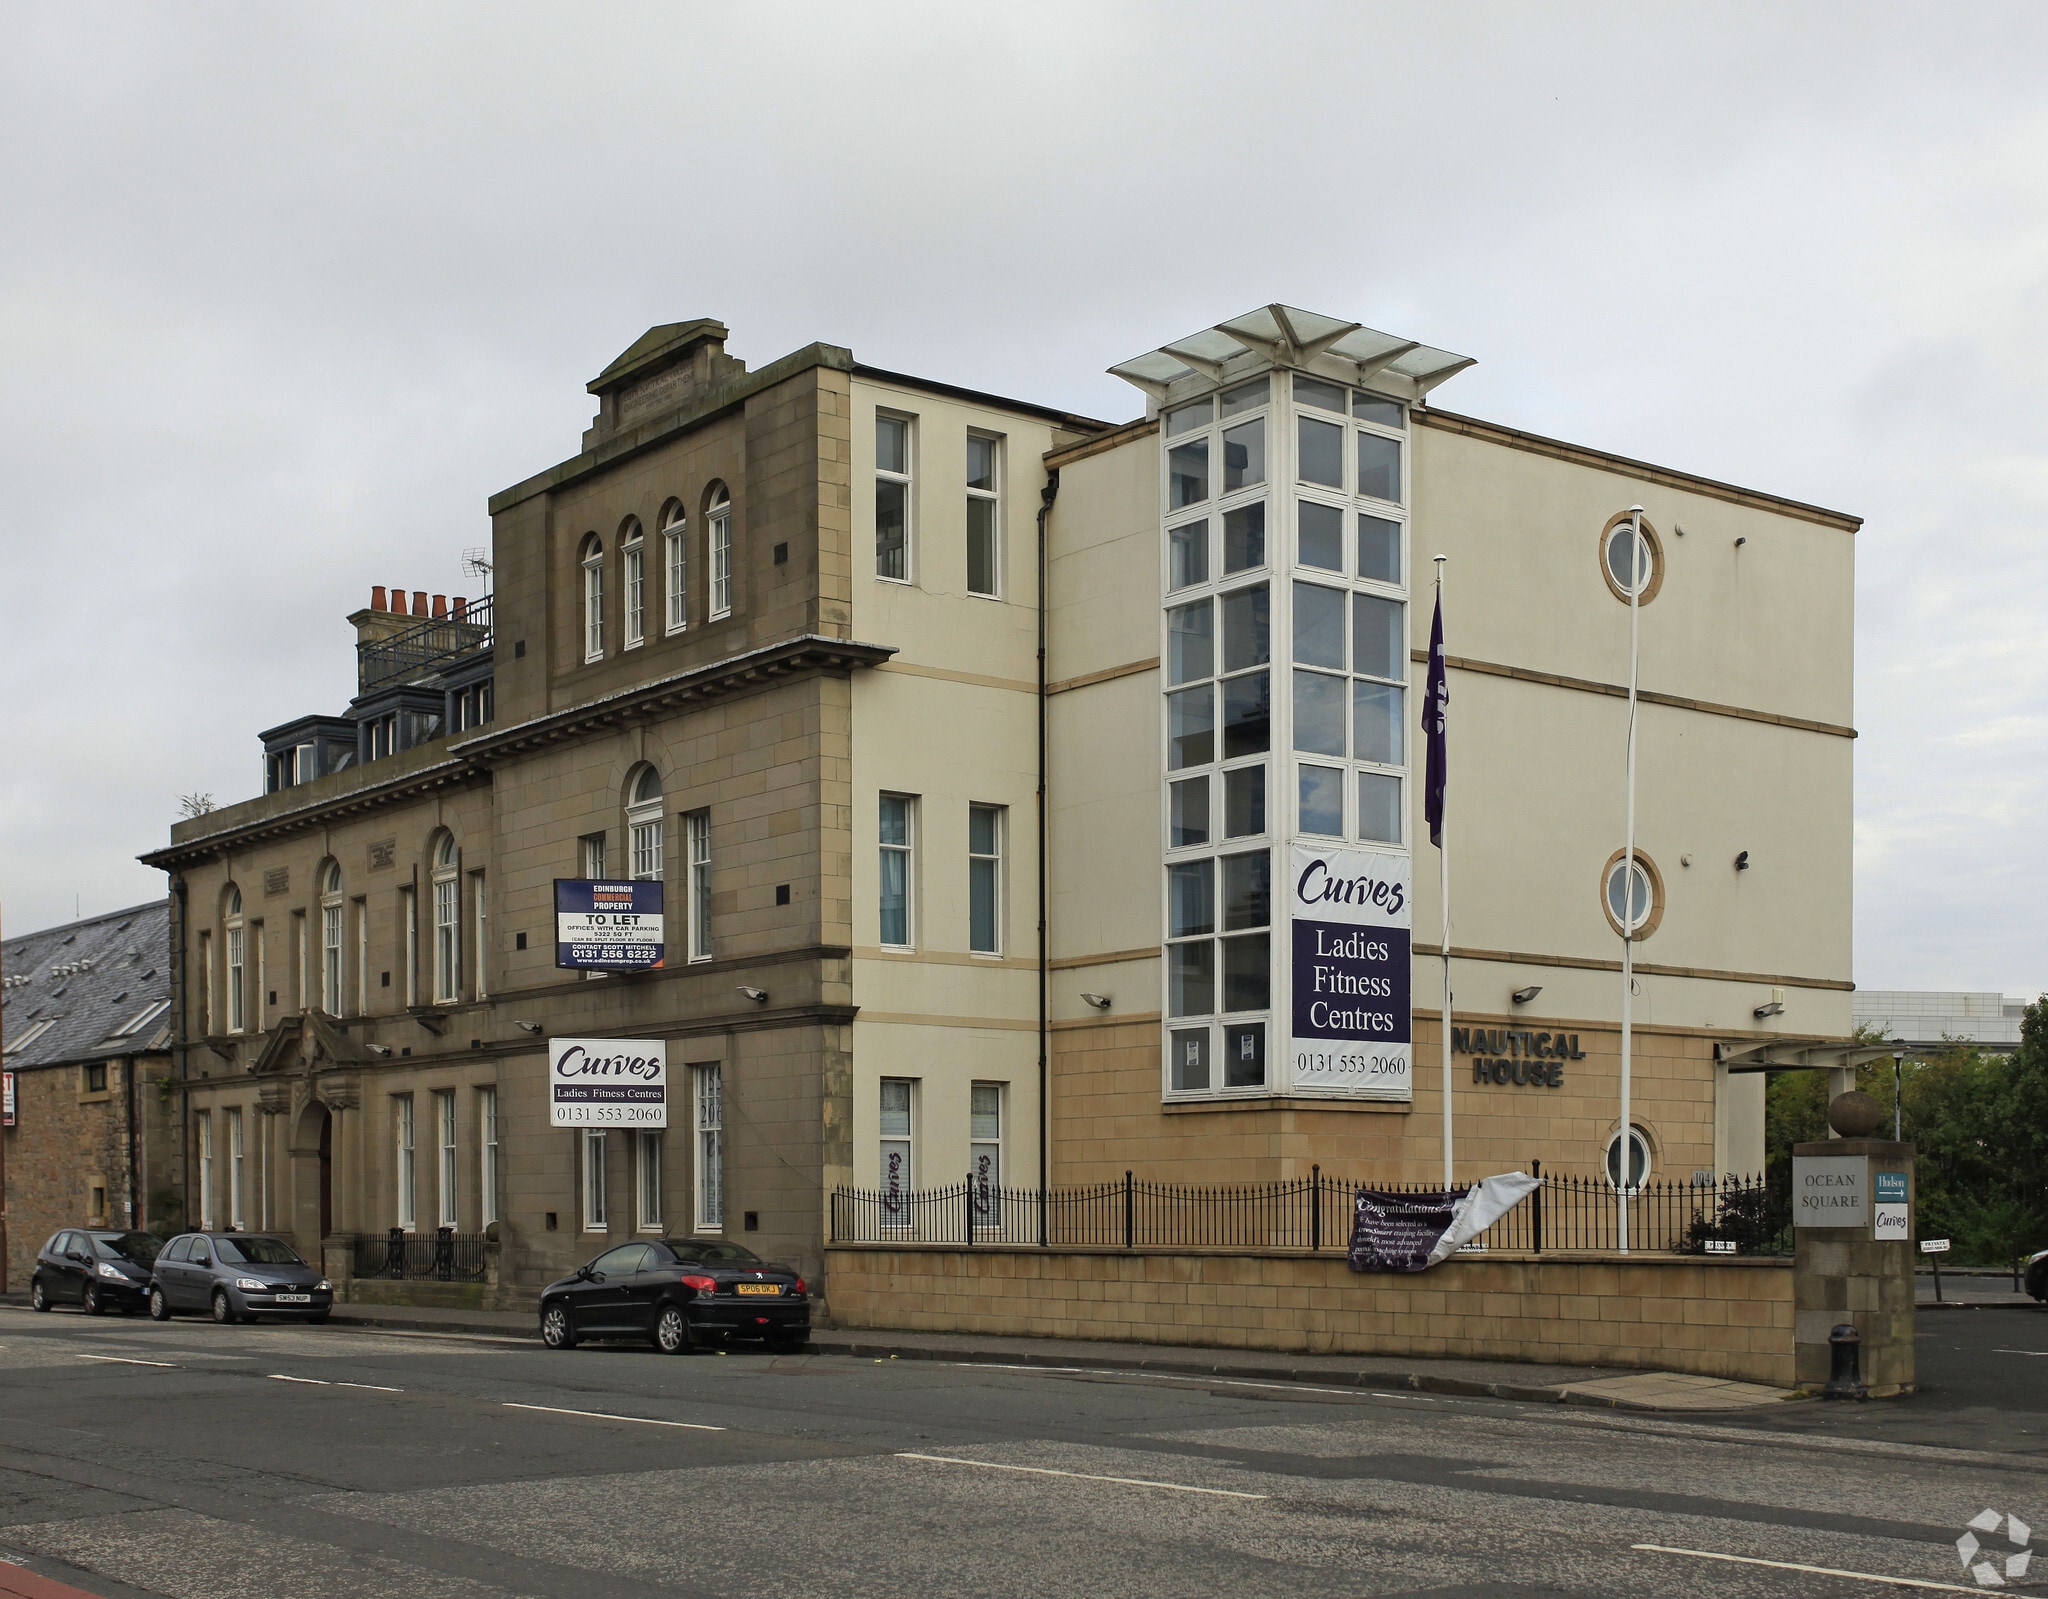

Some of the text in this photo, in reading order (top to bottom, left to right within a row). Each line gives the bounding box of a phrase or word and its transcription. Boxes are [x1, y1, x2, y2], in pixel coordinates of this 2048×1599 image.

[1297, 859, 1404, 915] Curves
[594, 893, 632, 901] COMMERCIAL
[594, 902, 633, 910] PROPERTY
[586, 914, 640, 925] TO LET
[1315, 929, 1389, 961] Ladies
[572, 950, 656, 958] 0131 556 6222
[1313, 965, 1391, 997] Fitness
[1310, 1001, 1394, 1031] Centres
[1451, 1027, 1586, 1060] NAUTICAL
[557, 1045, 661, 1080] Curves
[1298, 1053, 1405, 1074] 0131 553 2060
[1472, 1057, 1564, 1087] HOUSE
[557, 1088, 662, 1098] Ladies Fitness Centres
[557, 1108, 662, 1121] 0131 553 2060
[1805, 1175, 1856, 1186] OCEAN
[1878, 1176, 1904, 1187] Hudson
[1802, 1195, 1859, 1210] SQUARE
[1365, 1218, 1379, 1226] have
[1876, 1212, 1906, 1228] Curves
